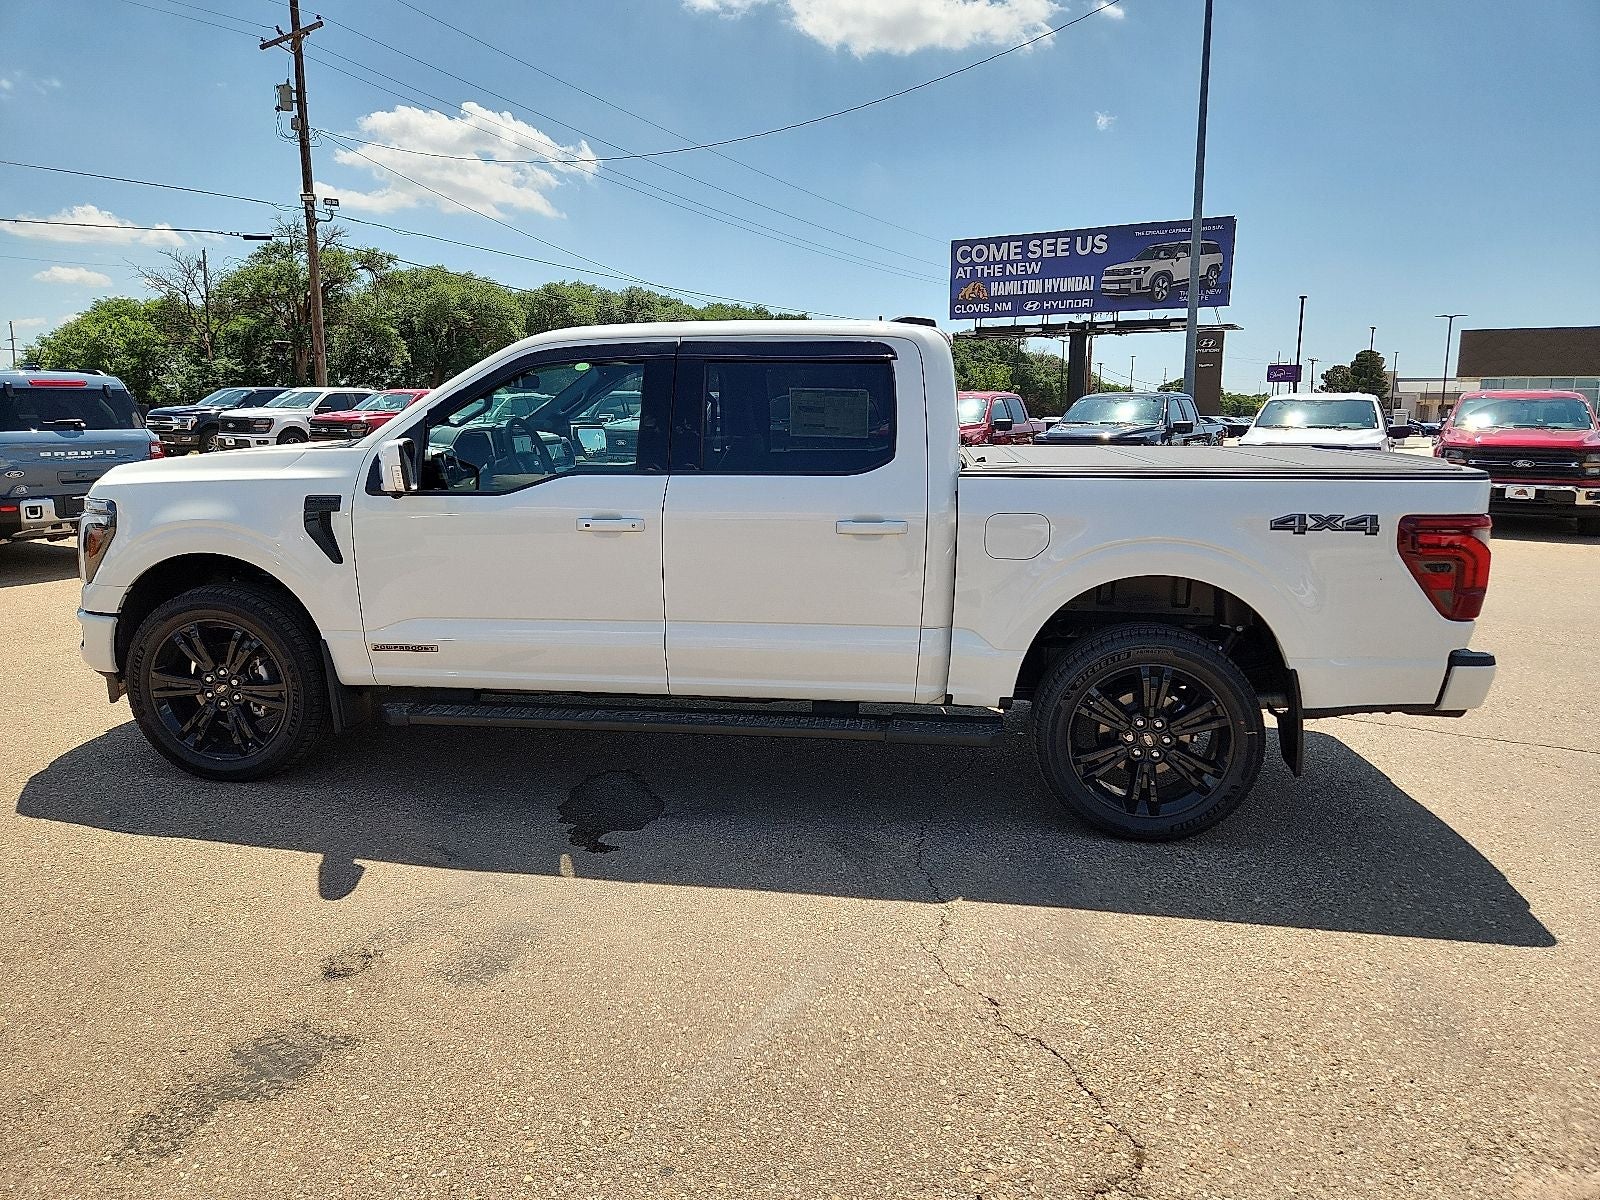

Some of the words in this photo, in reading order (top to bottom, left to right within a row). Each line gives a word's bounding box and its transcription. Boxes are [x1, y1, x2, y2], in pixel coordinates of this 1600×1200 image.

[956, 241, 1023, 264] COME
[1027, 238, 1071, 259] SEE
[1076, 234, 1108, 256] US
[955, 266, 973, 279] AT
[975, 264, 1004, 278] THE
[1006, 261, 1041, 276] NEW
[990, 279, 1043, 297] HAMILTON
[1044, 275, 1095, 293] HYUNDAI
[954, 303, 993, 314] CLOVIS,
[994, 301, 1012, 312] NM
[1043, 299, 1094, 310] HYUNDAI
[39, 449, 116, 457] BRONCO
[1075, 652, 1129, 687] MICHELIN
